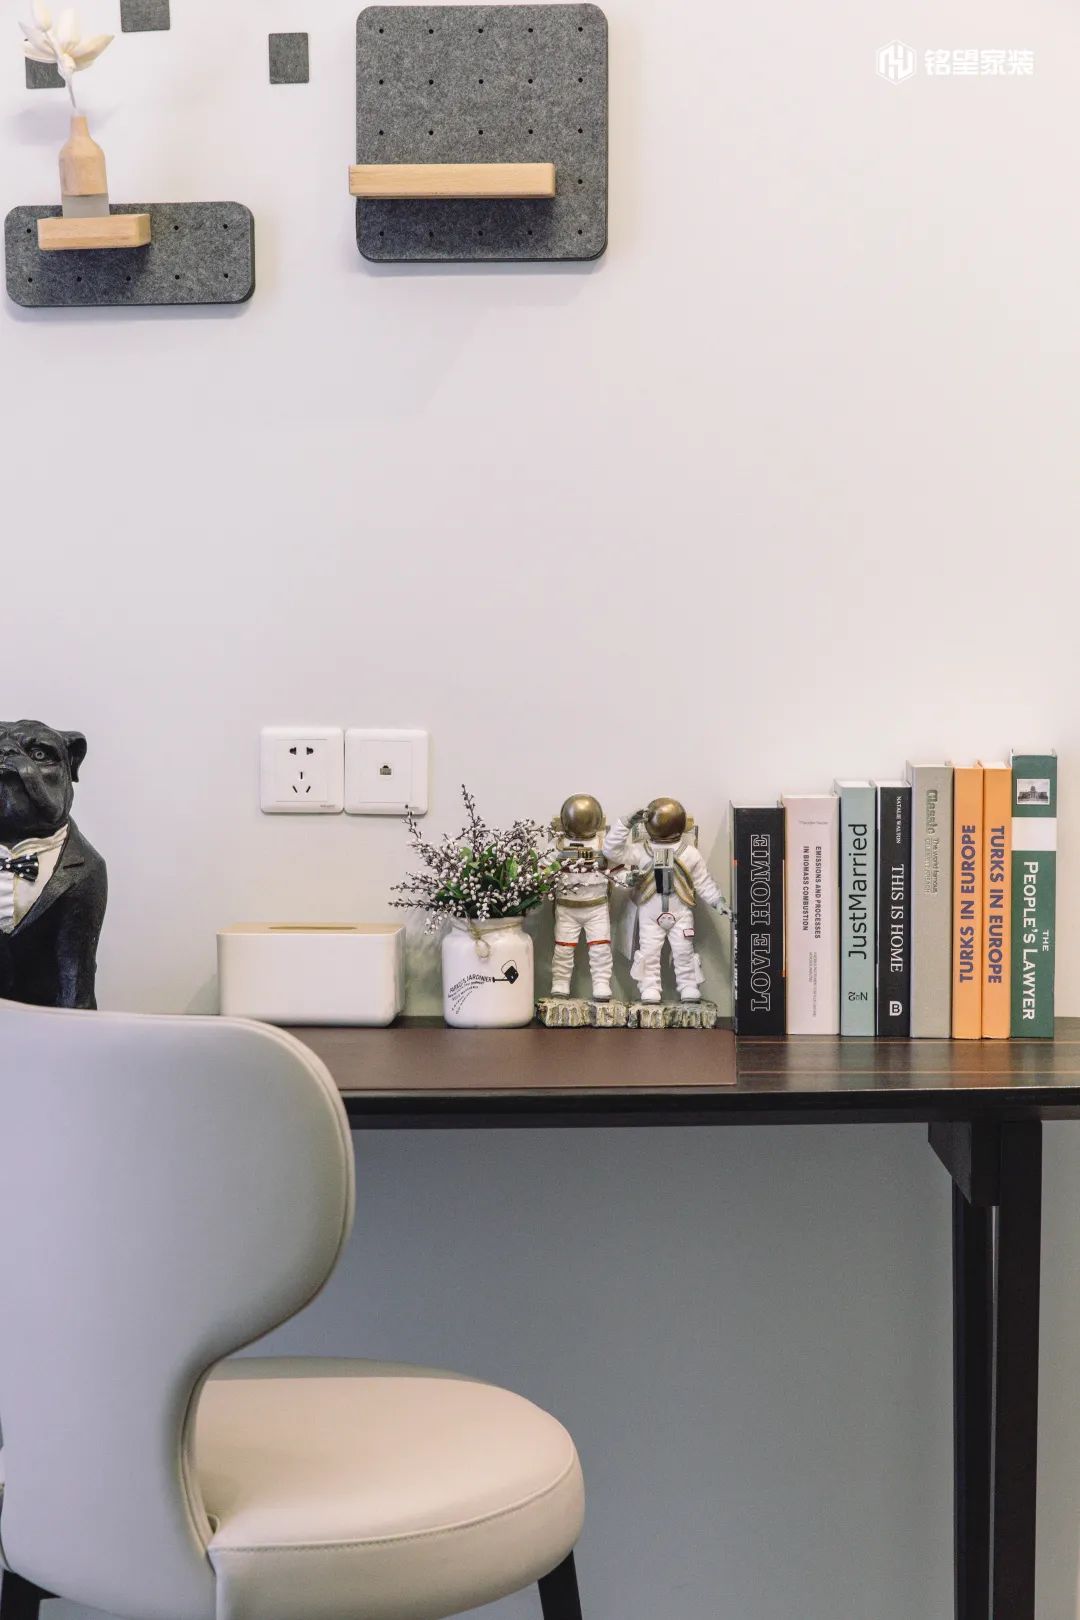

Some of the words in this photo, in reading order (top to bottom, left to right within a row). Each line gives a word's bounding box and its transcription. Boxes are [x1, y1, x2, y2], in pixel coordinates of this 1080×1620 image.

[803, 846, 810, 854] IN
[814, 846, 822, 883] EMISSIONS
[961, 824, 976, 895] EUROPE
[989, 825, 1005, 882] TURKS
[750, 834, 771, 926] HOME
[814, 884, 822, 898] AND
[848, 823, 868, 960] JustMarried
[891, 864, 904, 901] THIS
[988, 887, 1003, 909] IN
[1023, 861, 1039, 944] PEOPLE'S
[802, 886, 810, 931] COMBUSTION
[813, 899, 821, 939] PROCESSES
[891, 905, 904, 919] IS
[960, 900, 975, 922] IN
[750, 933, 771, 1012] LOVE
[890, 923, 903, 973] HOME
[959, 927, 974, 983] TURKS
[987, 914, 1003, 984] EUROPE
[1022, 948, 1038, 1020] LAWYER
